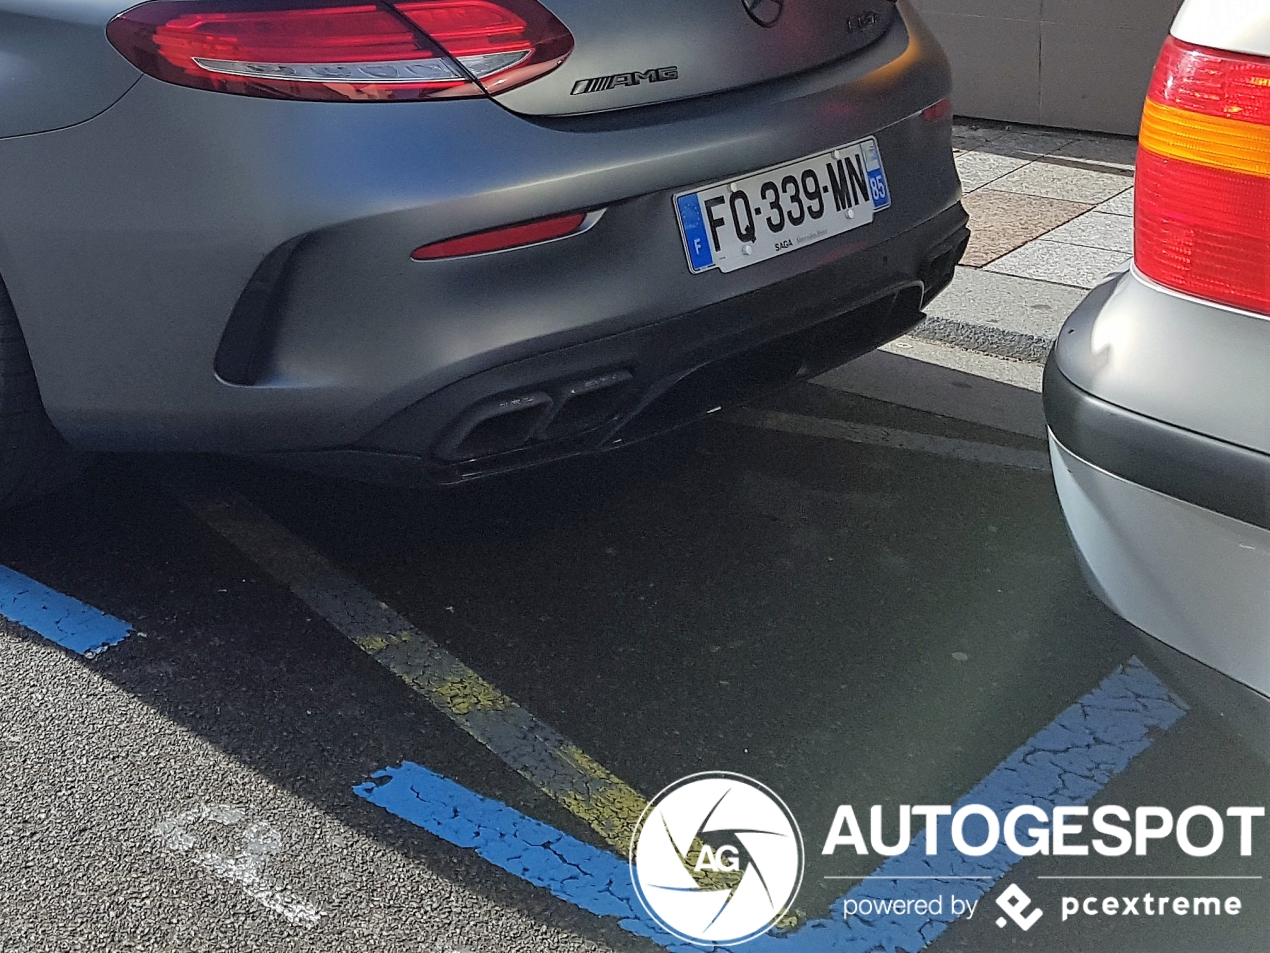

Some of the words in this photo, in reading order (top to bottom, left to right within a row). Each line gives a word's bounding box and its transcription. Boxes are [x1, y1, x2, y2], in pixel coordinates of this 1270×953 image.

[693, 238, 702, 255] F
[703, 153, 870, 252] FQ-339-MN
[870, 174, 886, 201] 85
[774, 238, 793, 252] SAGA
